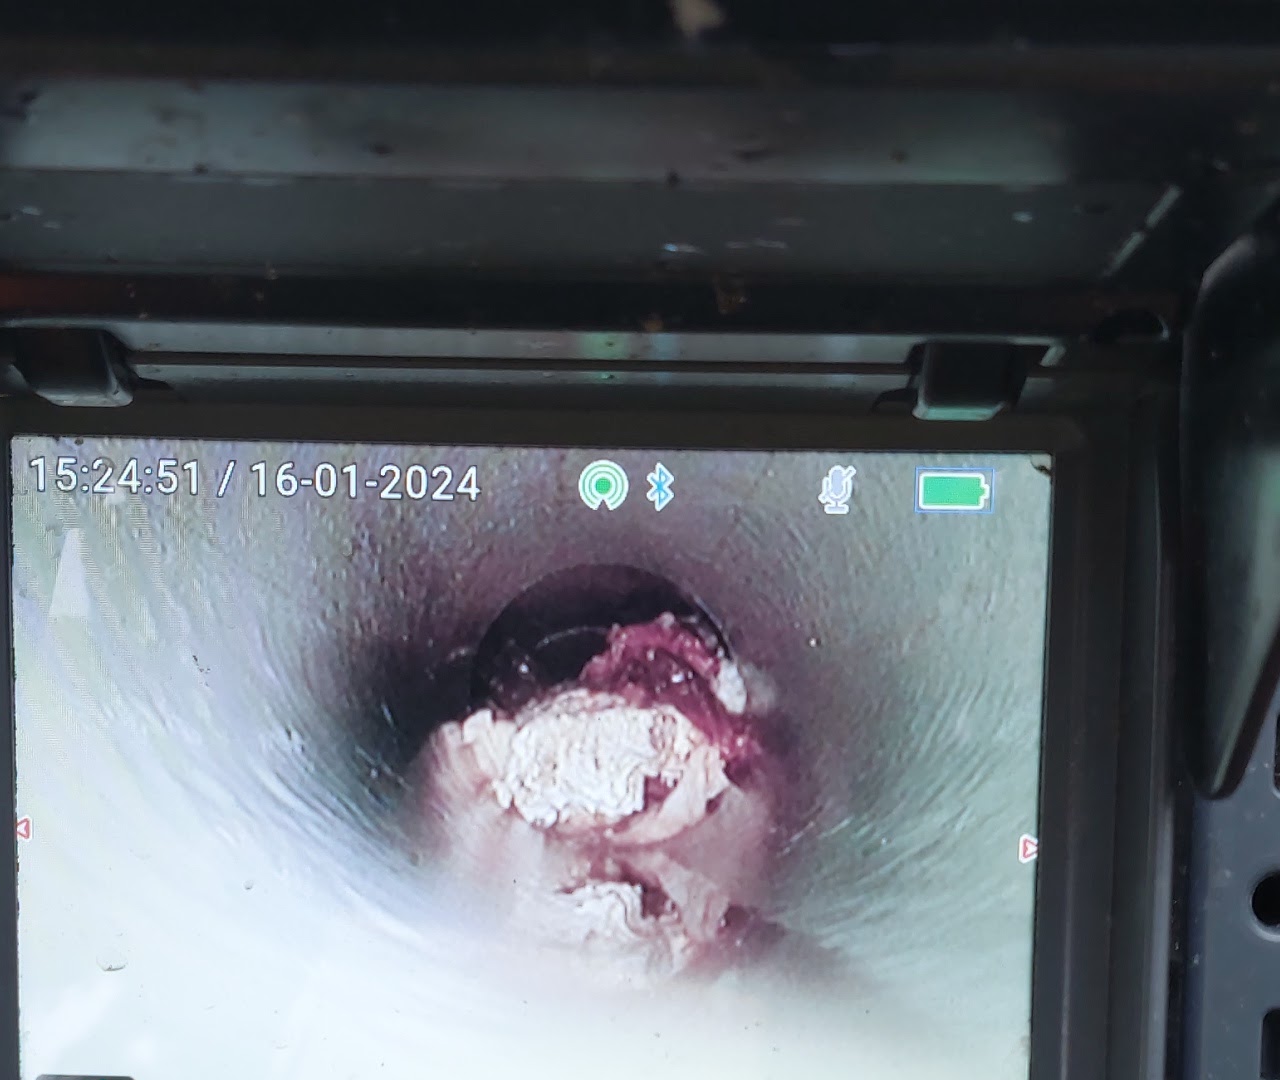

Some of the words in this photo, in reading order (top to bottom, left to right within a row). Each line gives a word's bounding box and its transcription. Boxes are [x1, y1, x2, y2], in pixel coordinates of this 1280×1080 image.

[29, 456, 201, 495] 15:24:51
[216, 459, 237, 498] /
[249, 460, 482, 502] 16-01-2024
